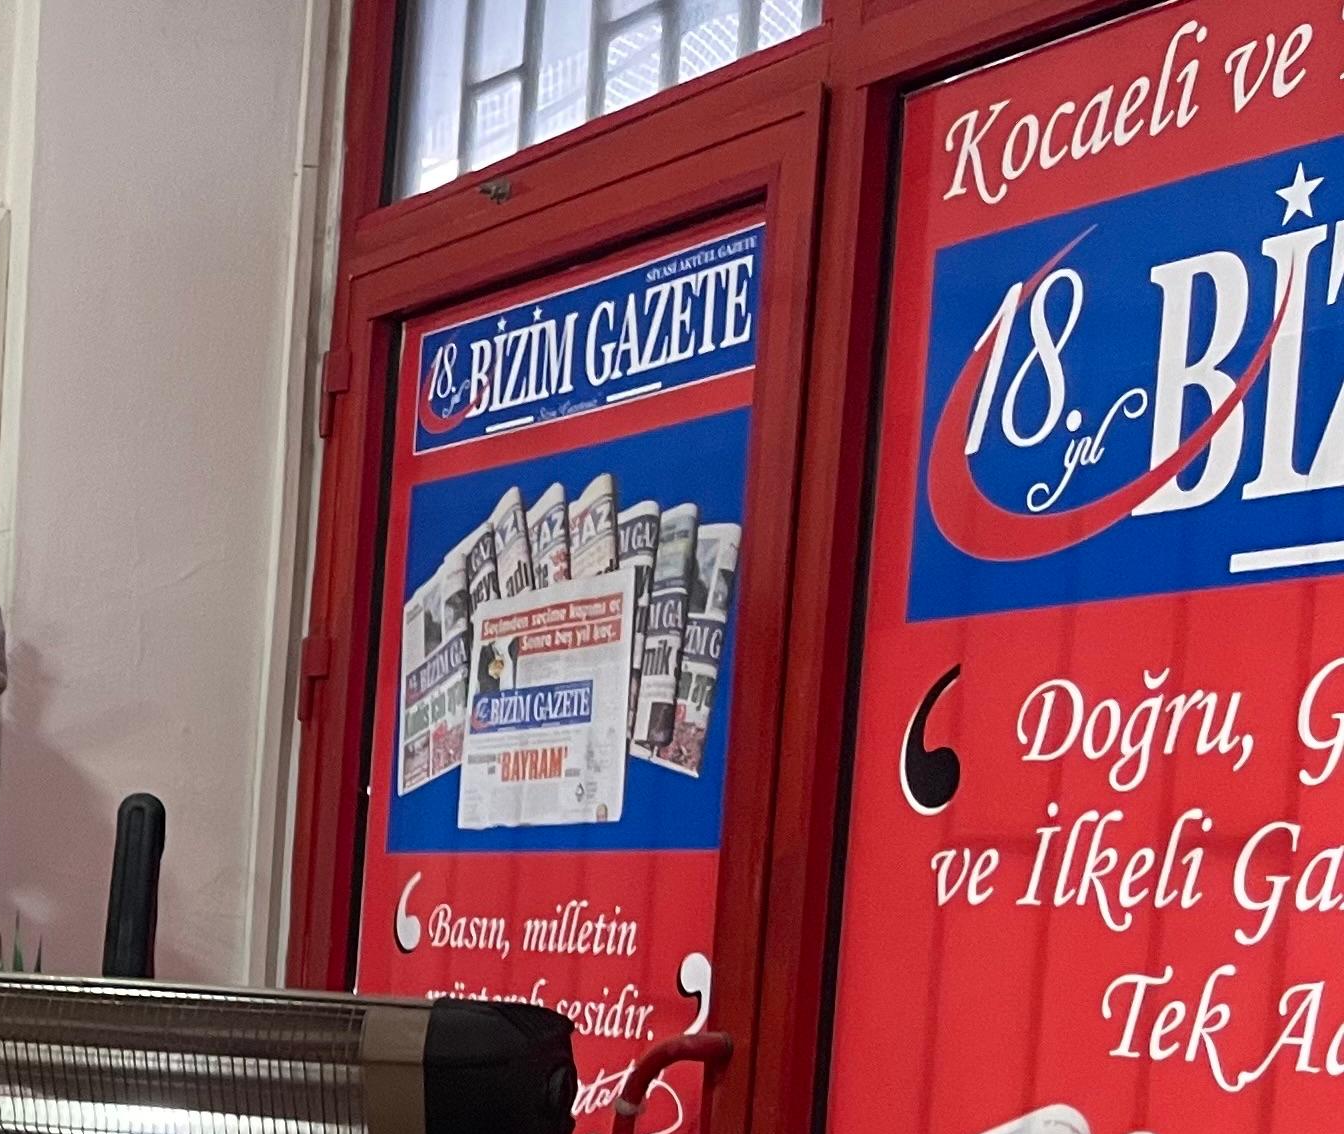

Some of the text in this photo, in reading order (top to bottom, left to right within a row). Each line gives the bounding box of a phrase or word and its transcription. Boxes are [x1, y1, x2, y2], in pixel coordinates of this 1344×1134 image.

[943, 19, 1314, 205] Kocaeli ve
[465, 254, 755, 419] BİZİM GAZETE
[964, 267, 1083, 456] 18.
[1132, 161, 1344, 517] Bİ
[490, 687, 592, 724] BİZİM GAZETE
[1016, 667, 1255, 793] Doğru,
[427, 900, 638, 960] Basın, milletin
[930, 802, 1344, 947] ve İlkeli Ga
[555, 983, 655, 1041] sesidir.
[1101, 964, 1246, 1093] Tek
